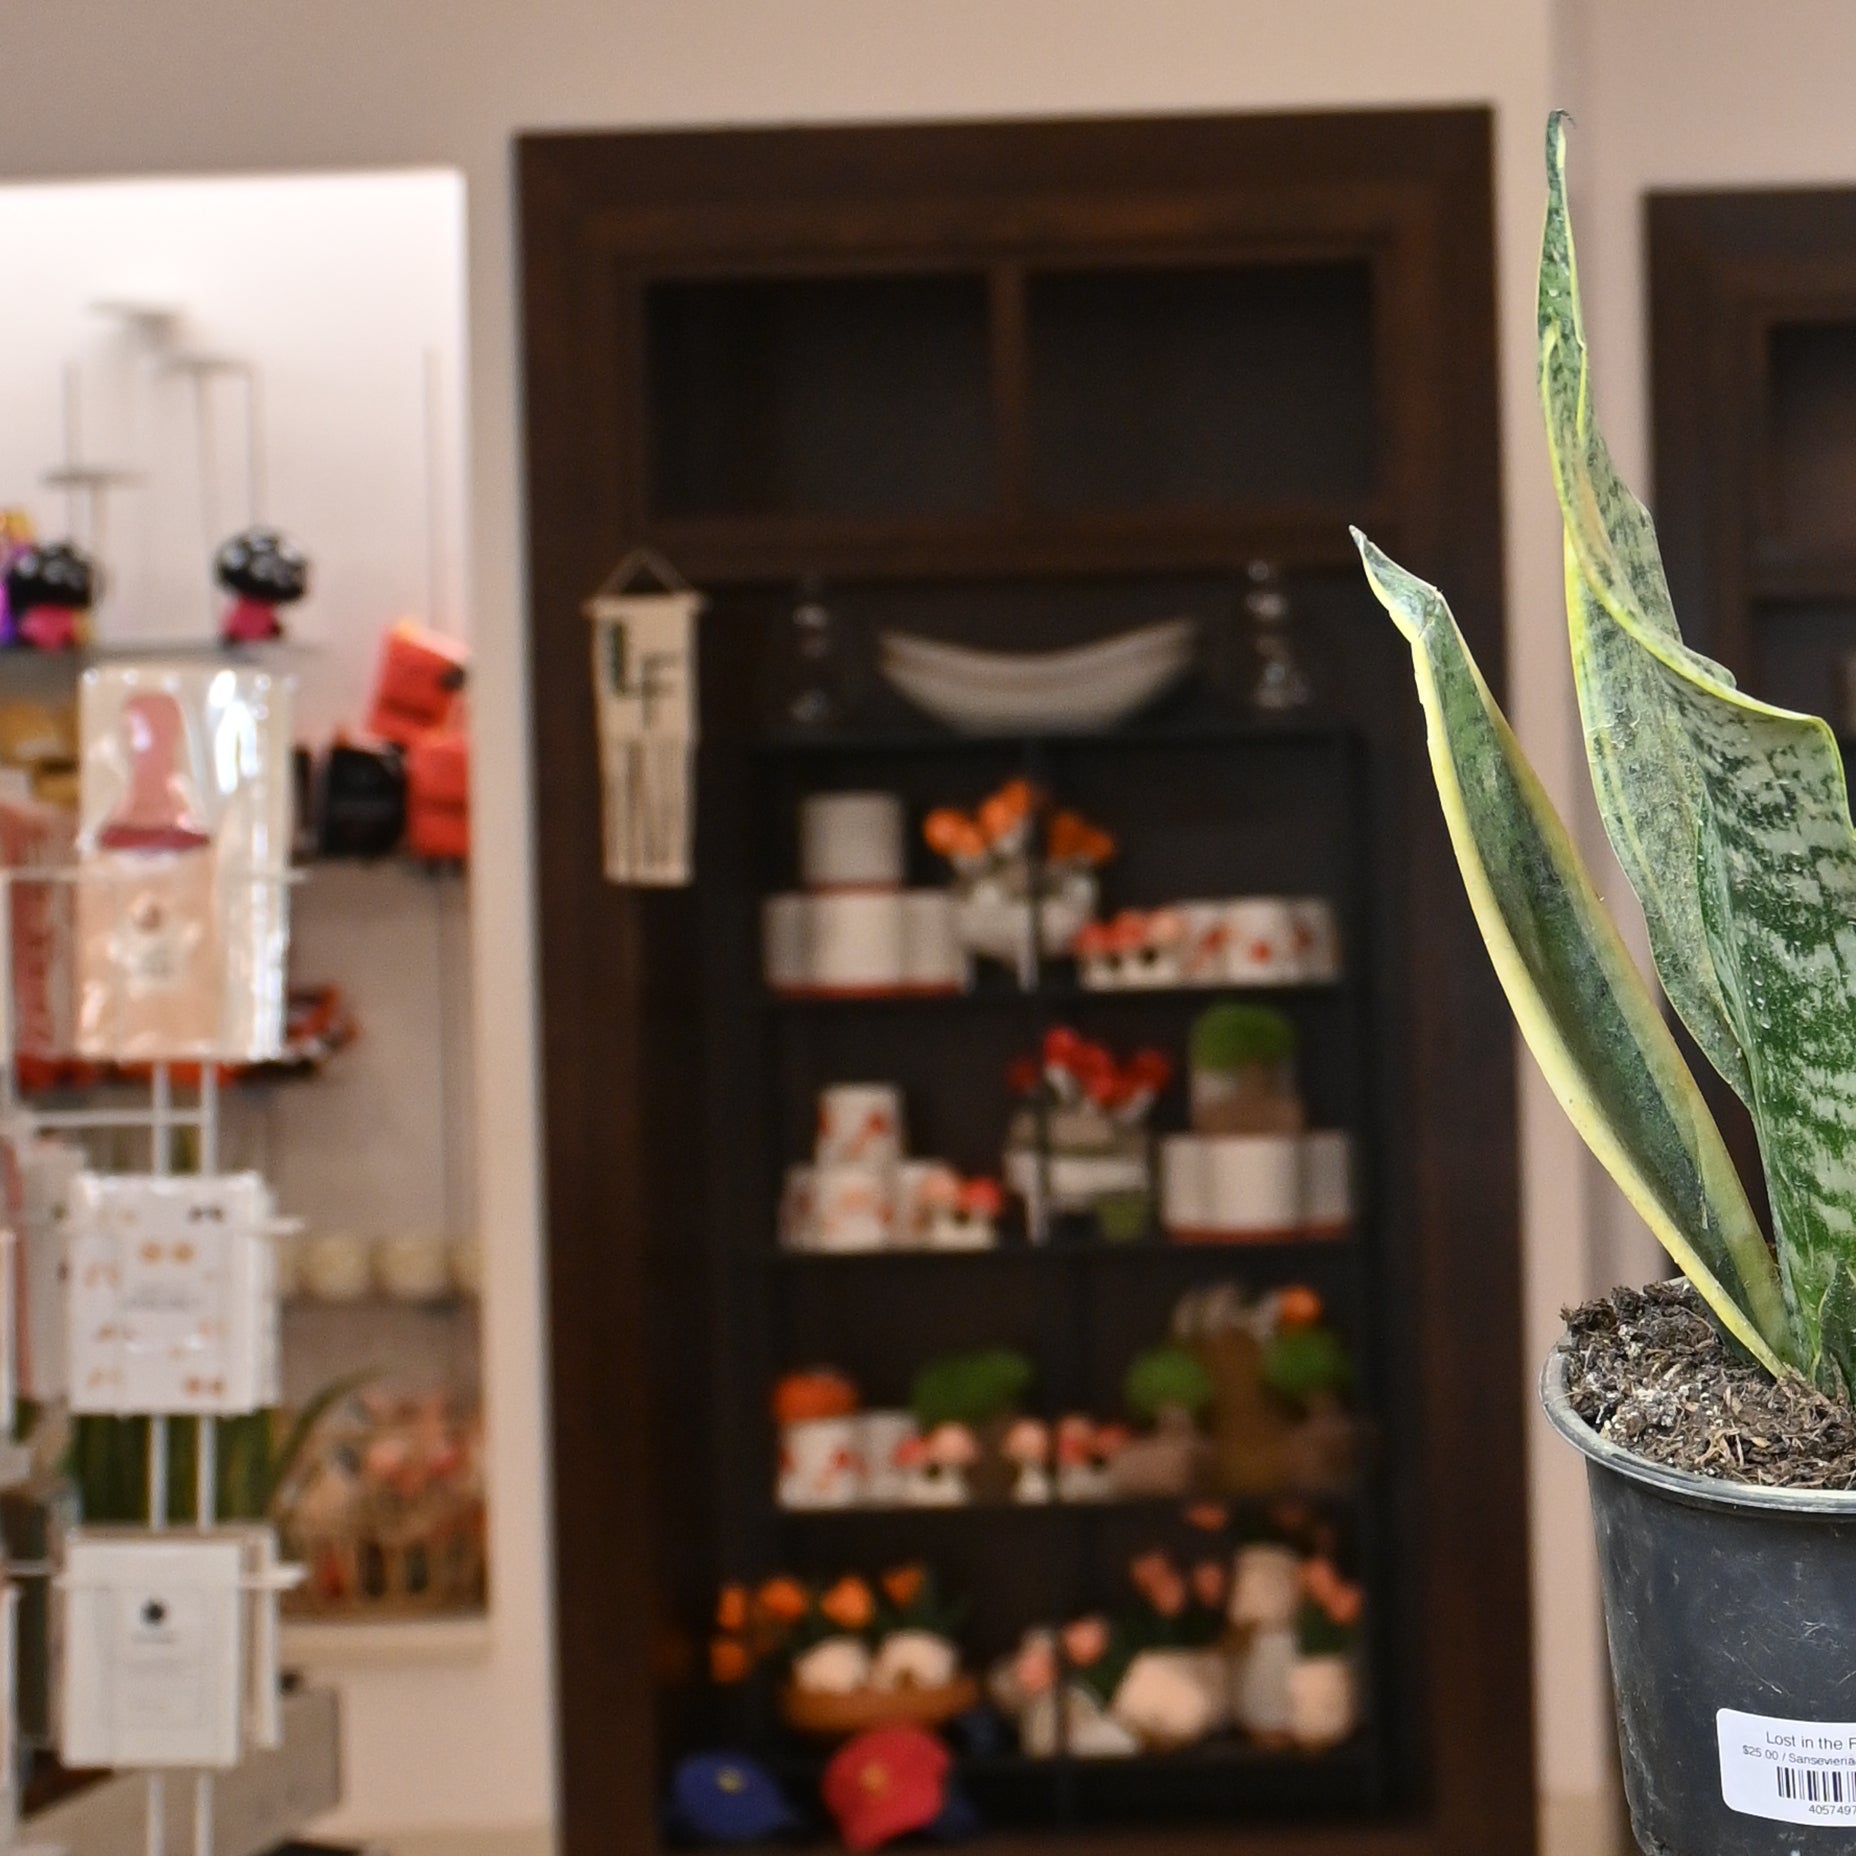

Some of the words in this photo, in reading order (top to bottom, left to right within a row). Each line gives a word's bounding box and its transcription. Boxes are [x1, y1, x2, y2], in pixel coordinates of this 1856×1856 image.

[1766, 1731, 1796, 1747] Lost
[1801, 1736, 1814, 1749] in
[1818, 1737, 1843, 1750] the
[1782, 1752, 1787, 1762] /
[1788, 1752, 1856, 1766] Sansevieria
